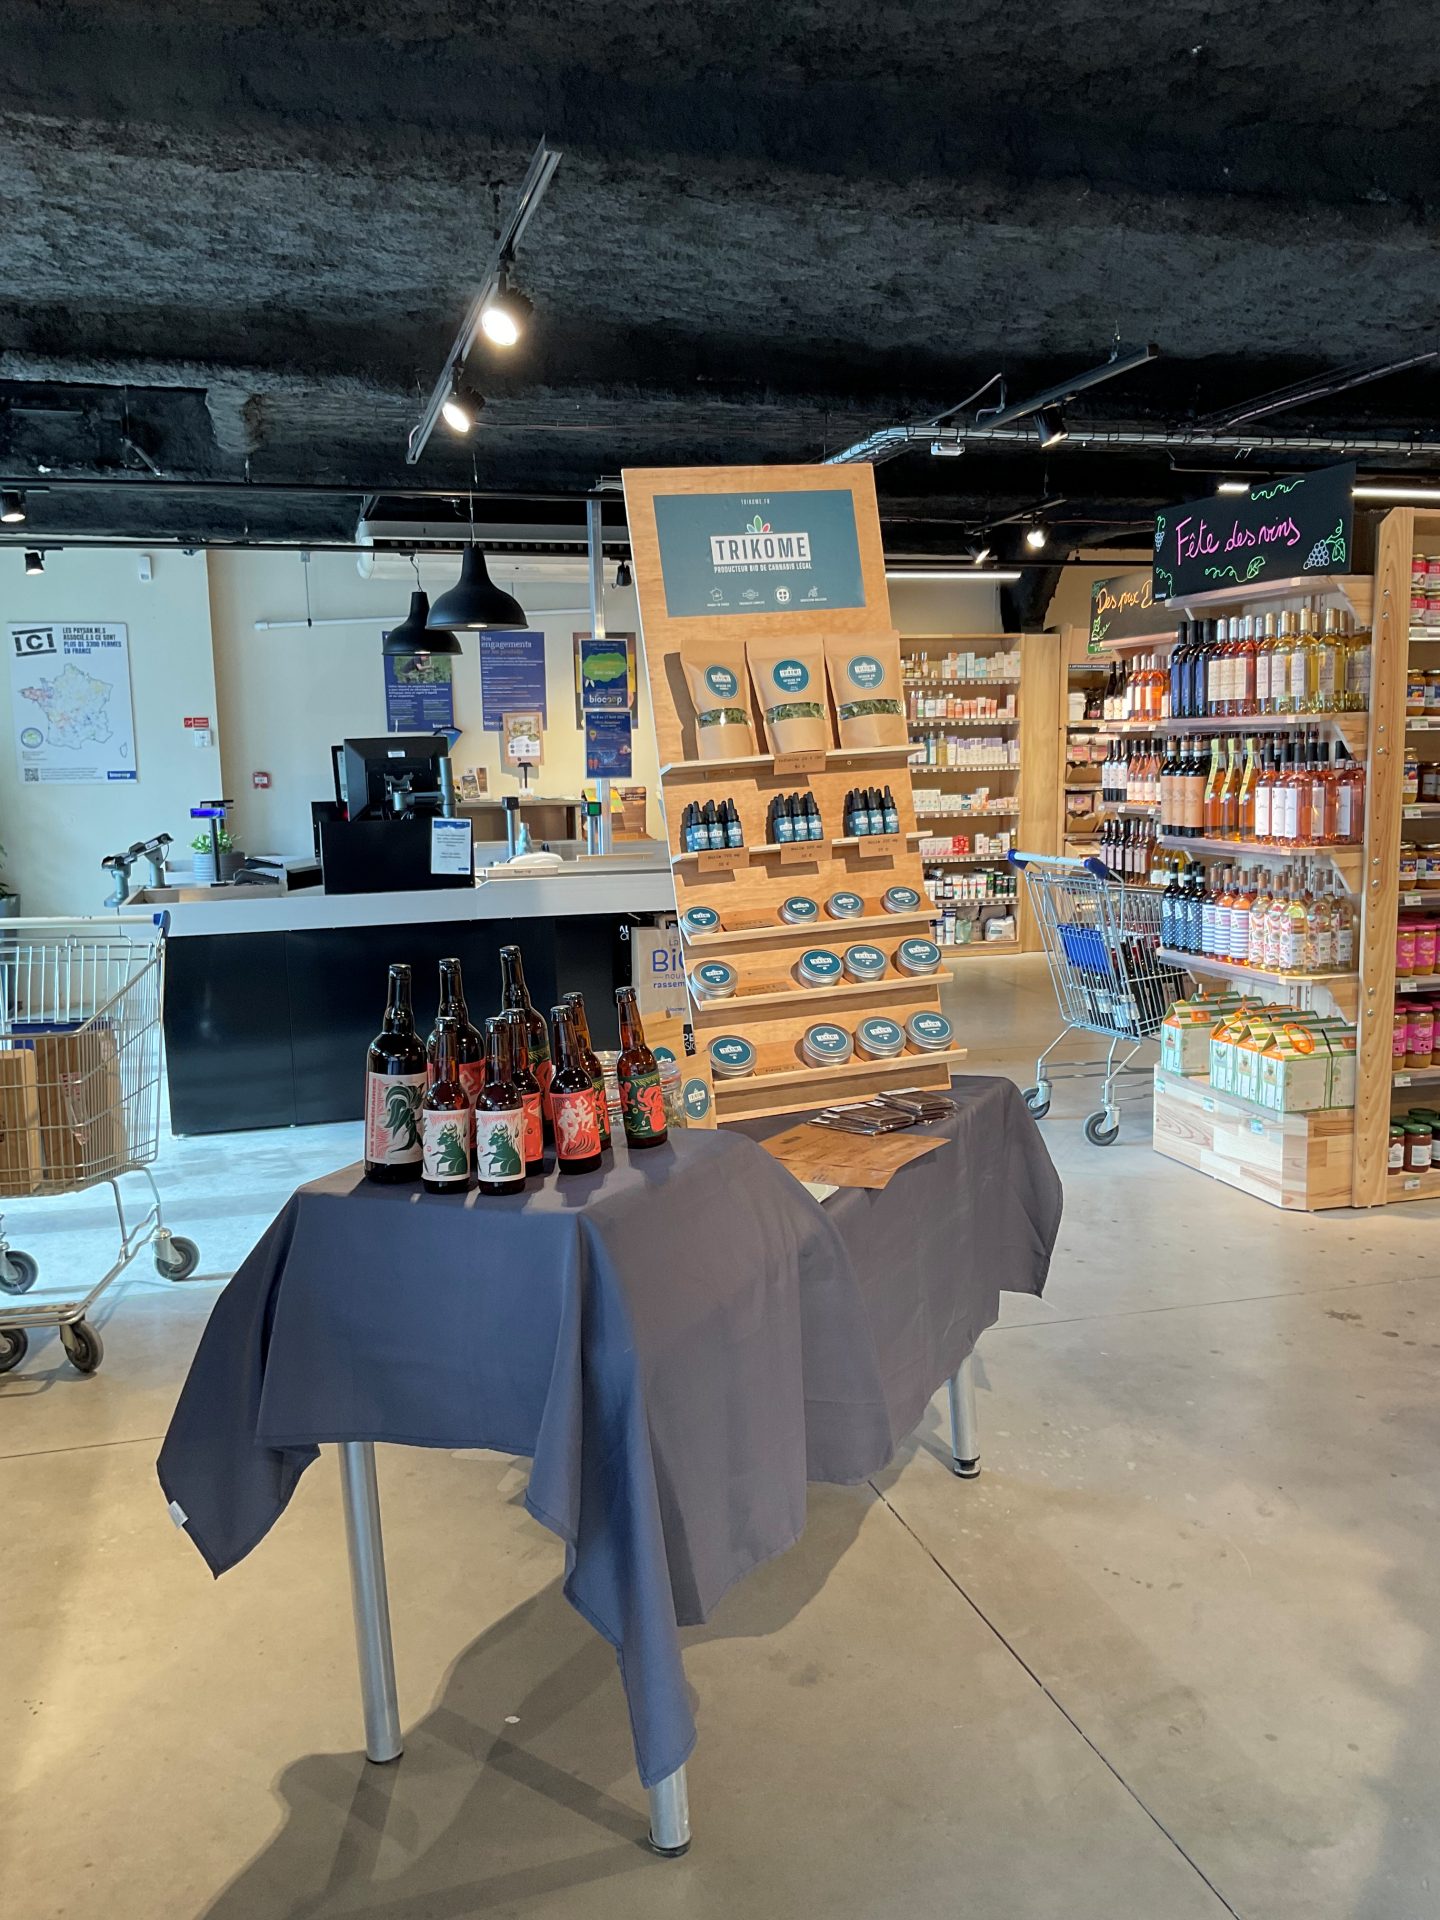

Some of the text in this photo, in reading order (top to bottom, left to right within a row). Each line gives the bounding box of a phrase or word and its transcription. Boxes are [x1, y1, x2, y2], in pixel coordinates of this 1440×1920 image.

[715, 537, 807, 561] TRIKOME
[1176, 517, 1301, 566] Fête des vins
[714, 565, 748, 574] PRODUCTEUR
[760, 564, 767, 572] DE
[768, 563, 795, 571] CANNABIS
[796, 561, 812, 570] LÉGAL
[1096, 588, 1117, 614] Des
[14, 633, 55, 651] ICI
[481, 640, 532, 650] engagements
